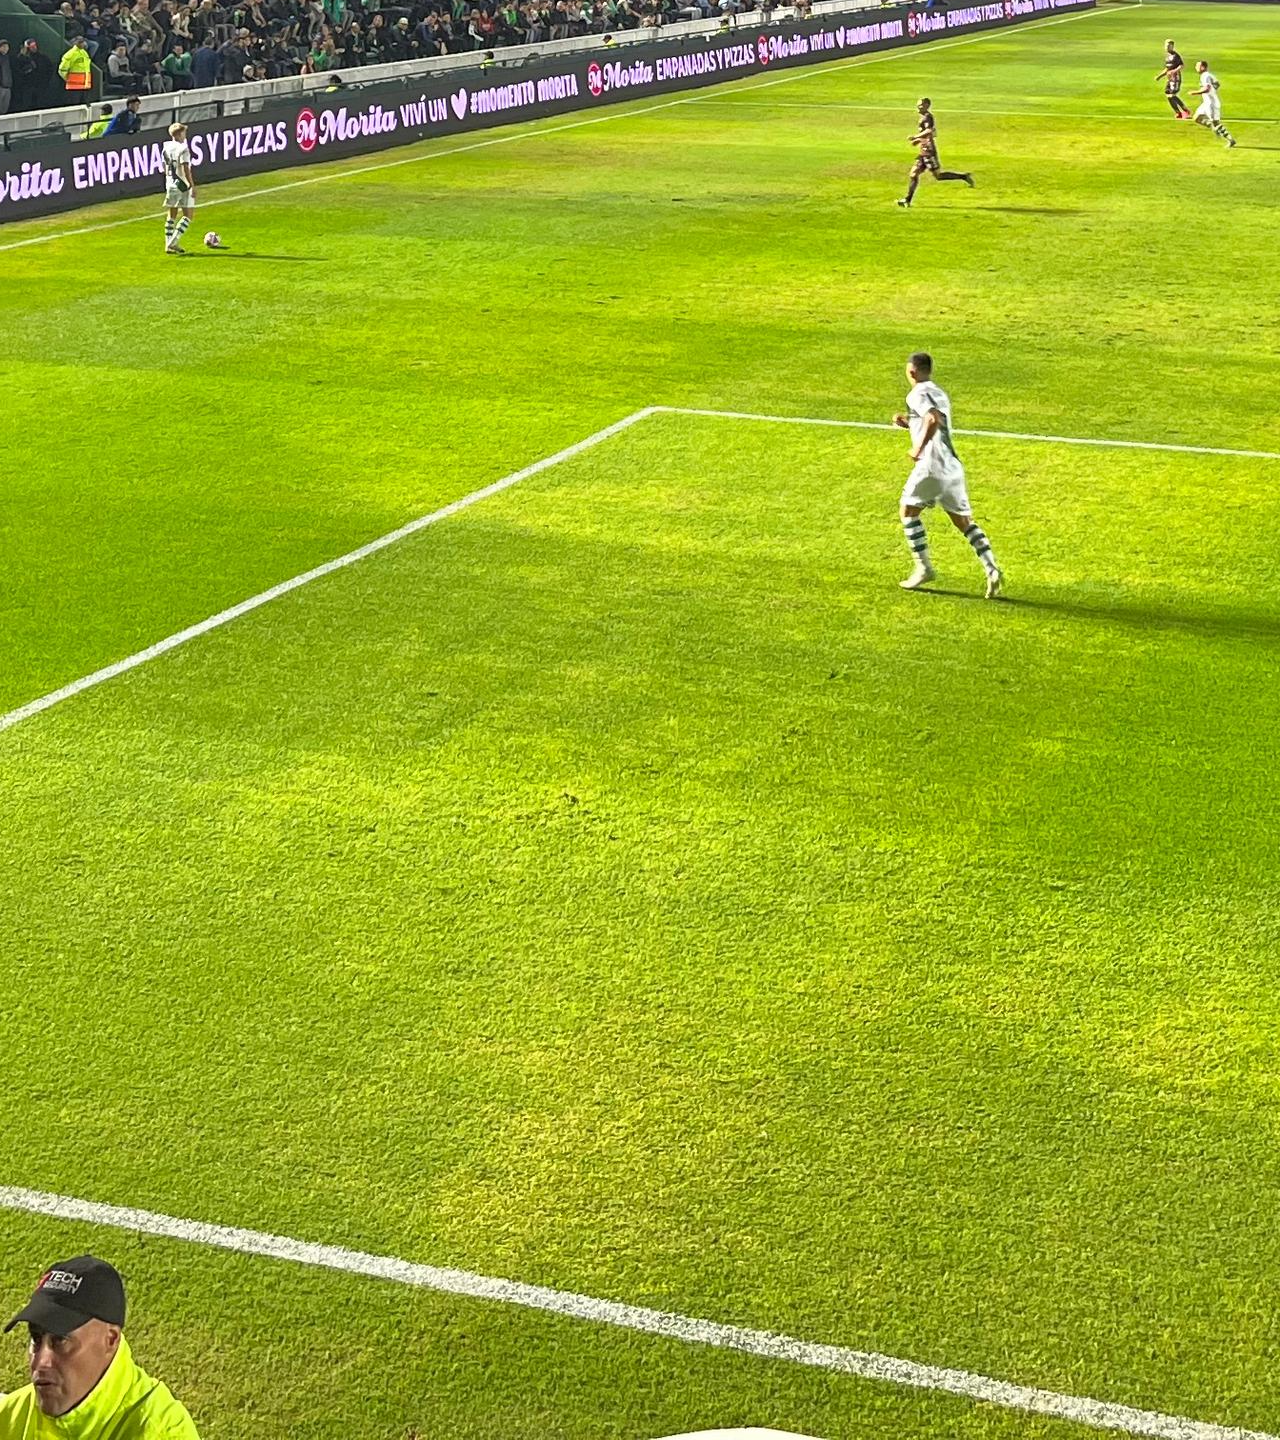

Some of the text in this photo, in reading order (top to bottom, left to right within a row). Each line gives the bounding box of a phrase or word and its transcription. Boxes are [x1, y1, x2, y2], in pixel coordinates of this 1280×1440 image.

[73, 135, 204, 190] EMPANAS
[206, 132, 220, 163] Y
[223, 121, 287, 160] PIZZAS
[318, 104, 397, 145] Morita
[400, 94, 426, 128] VIVÍ
[428, 98, 448, 122] UN
[603, 60, 654, 92] Morita
[655, 51, 716, 81] EMPANADAS
[715, 50, 724, 70] Y
[724, 43, 755, 69] PIZZAS
[768, 34, 808, 60] Morita
[48, 1270, 83, 1289] TECH
